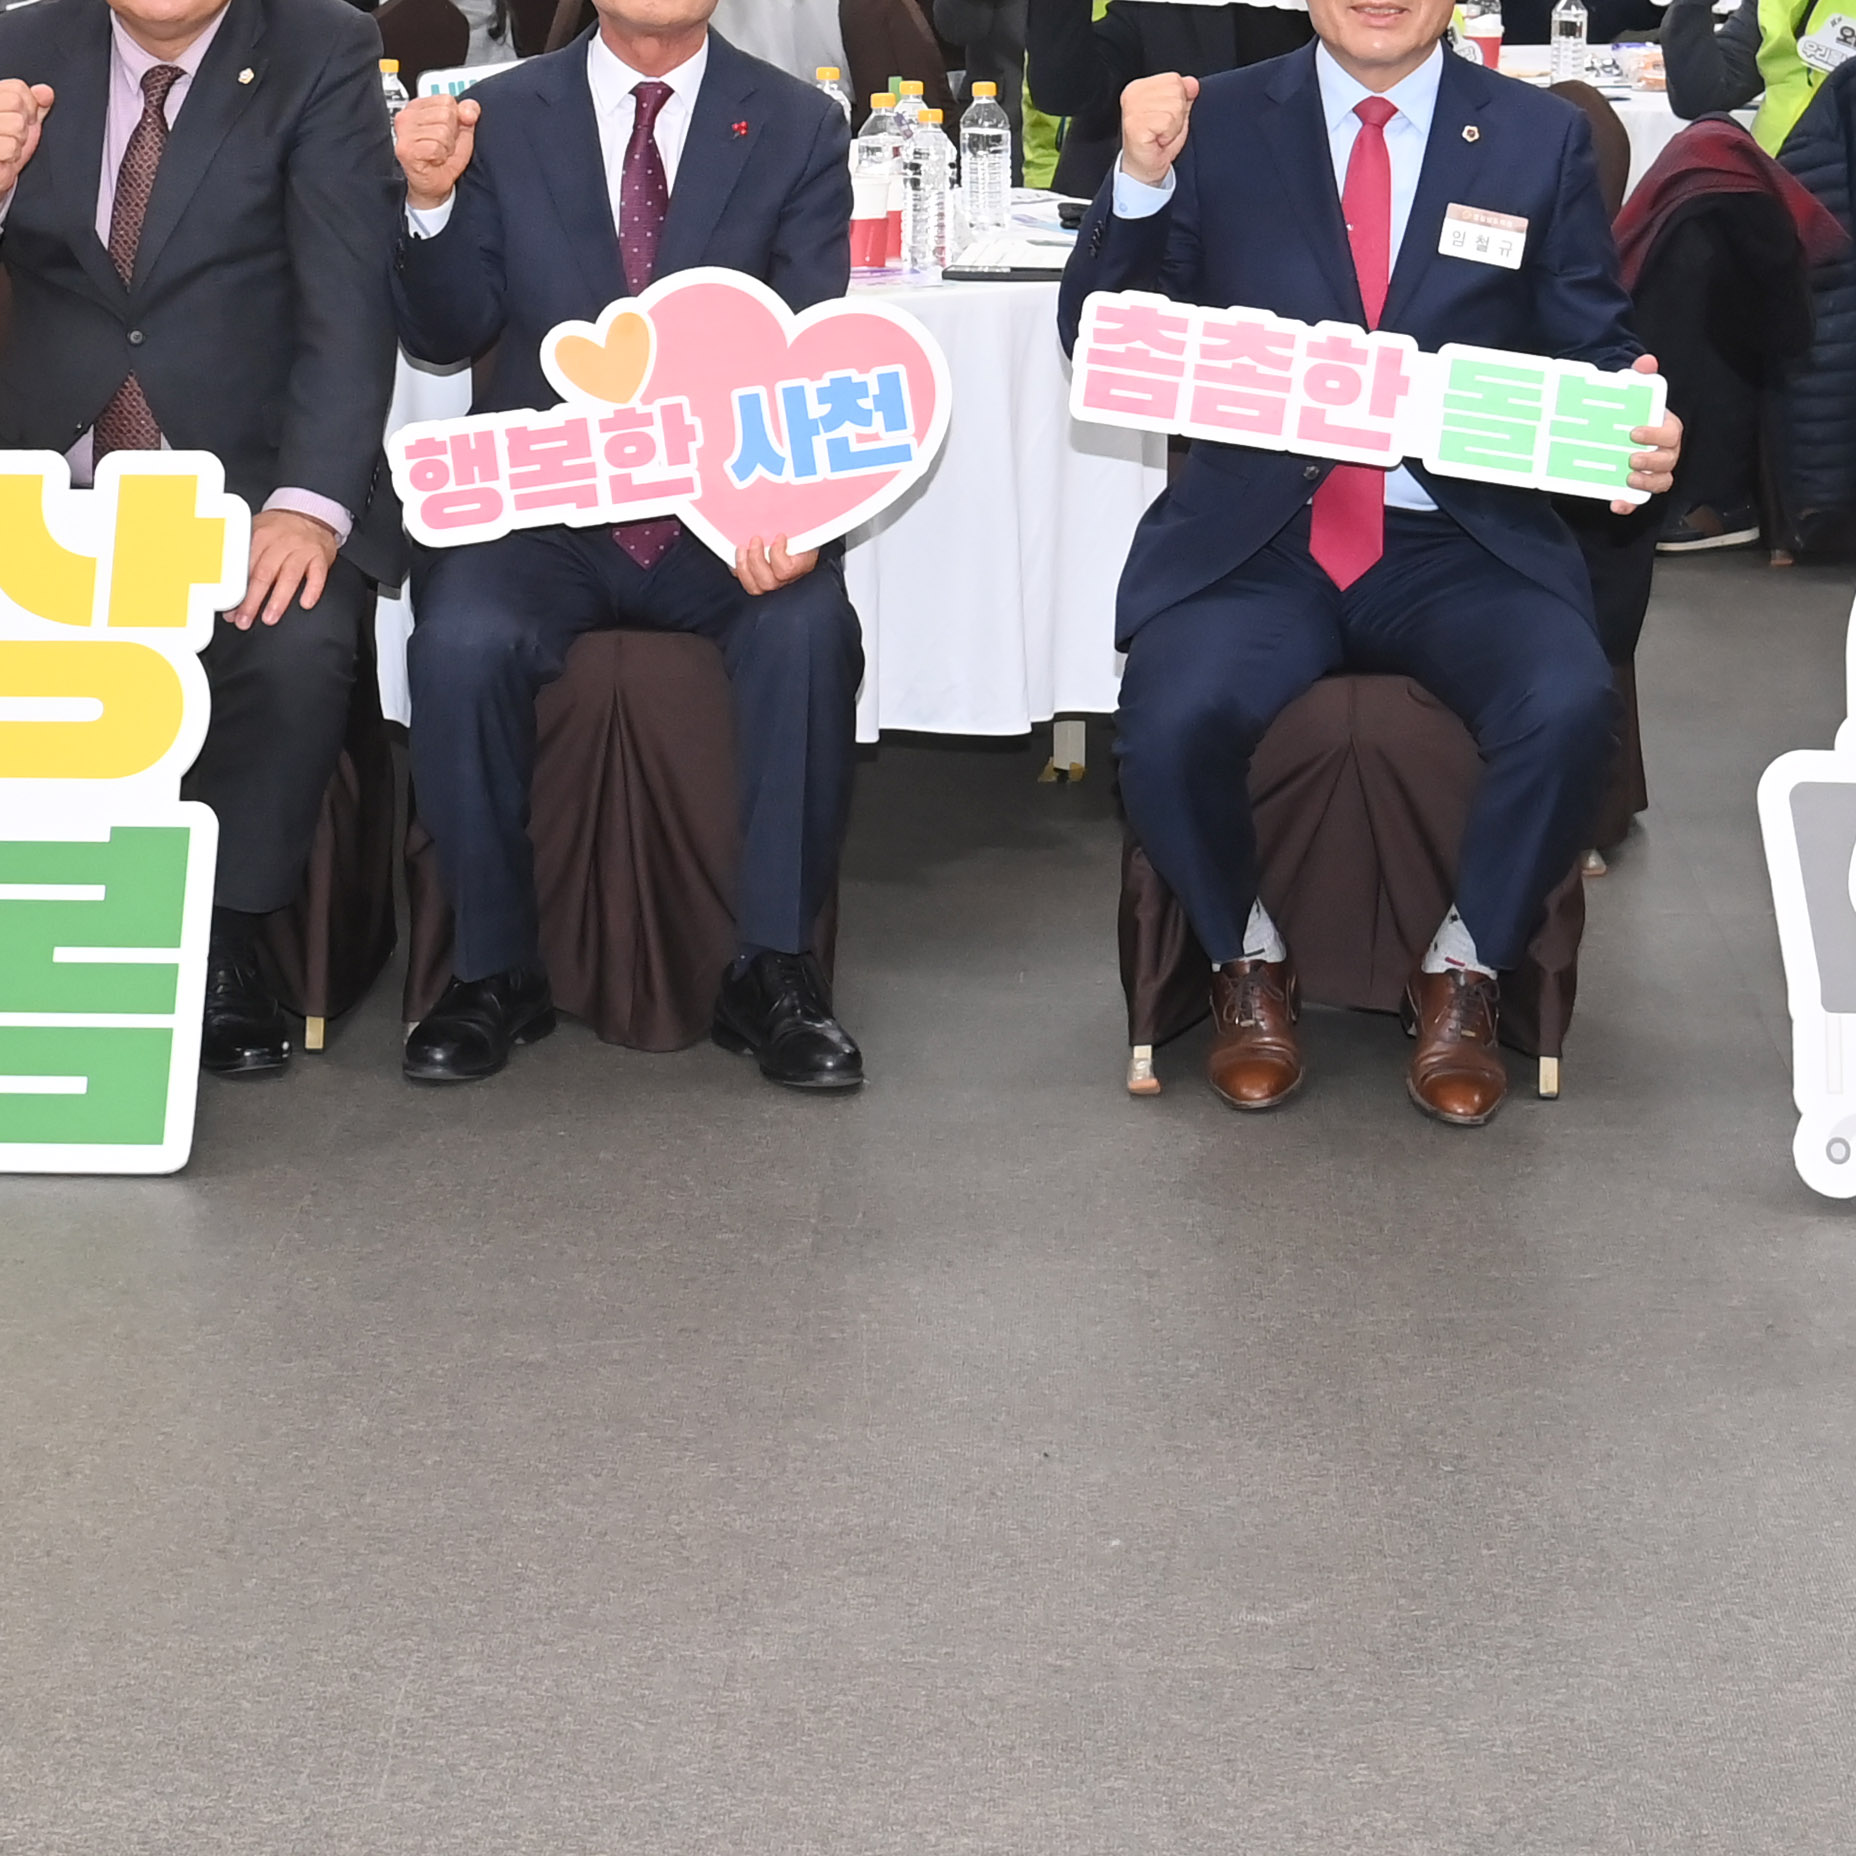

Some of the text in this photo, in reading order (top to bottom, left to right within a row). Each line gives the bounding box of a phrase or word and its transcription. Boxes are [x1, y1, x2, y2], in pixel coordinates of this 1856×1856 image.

[405, 370, 914, 531] 행복한 사천
[1082, 303, 1653, 487] 촘촘한 돌봄
